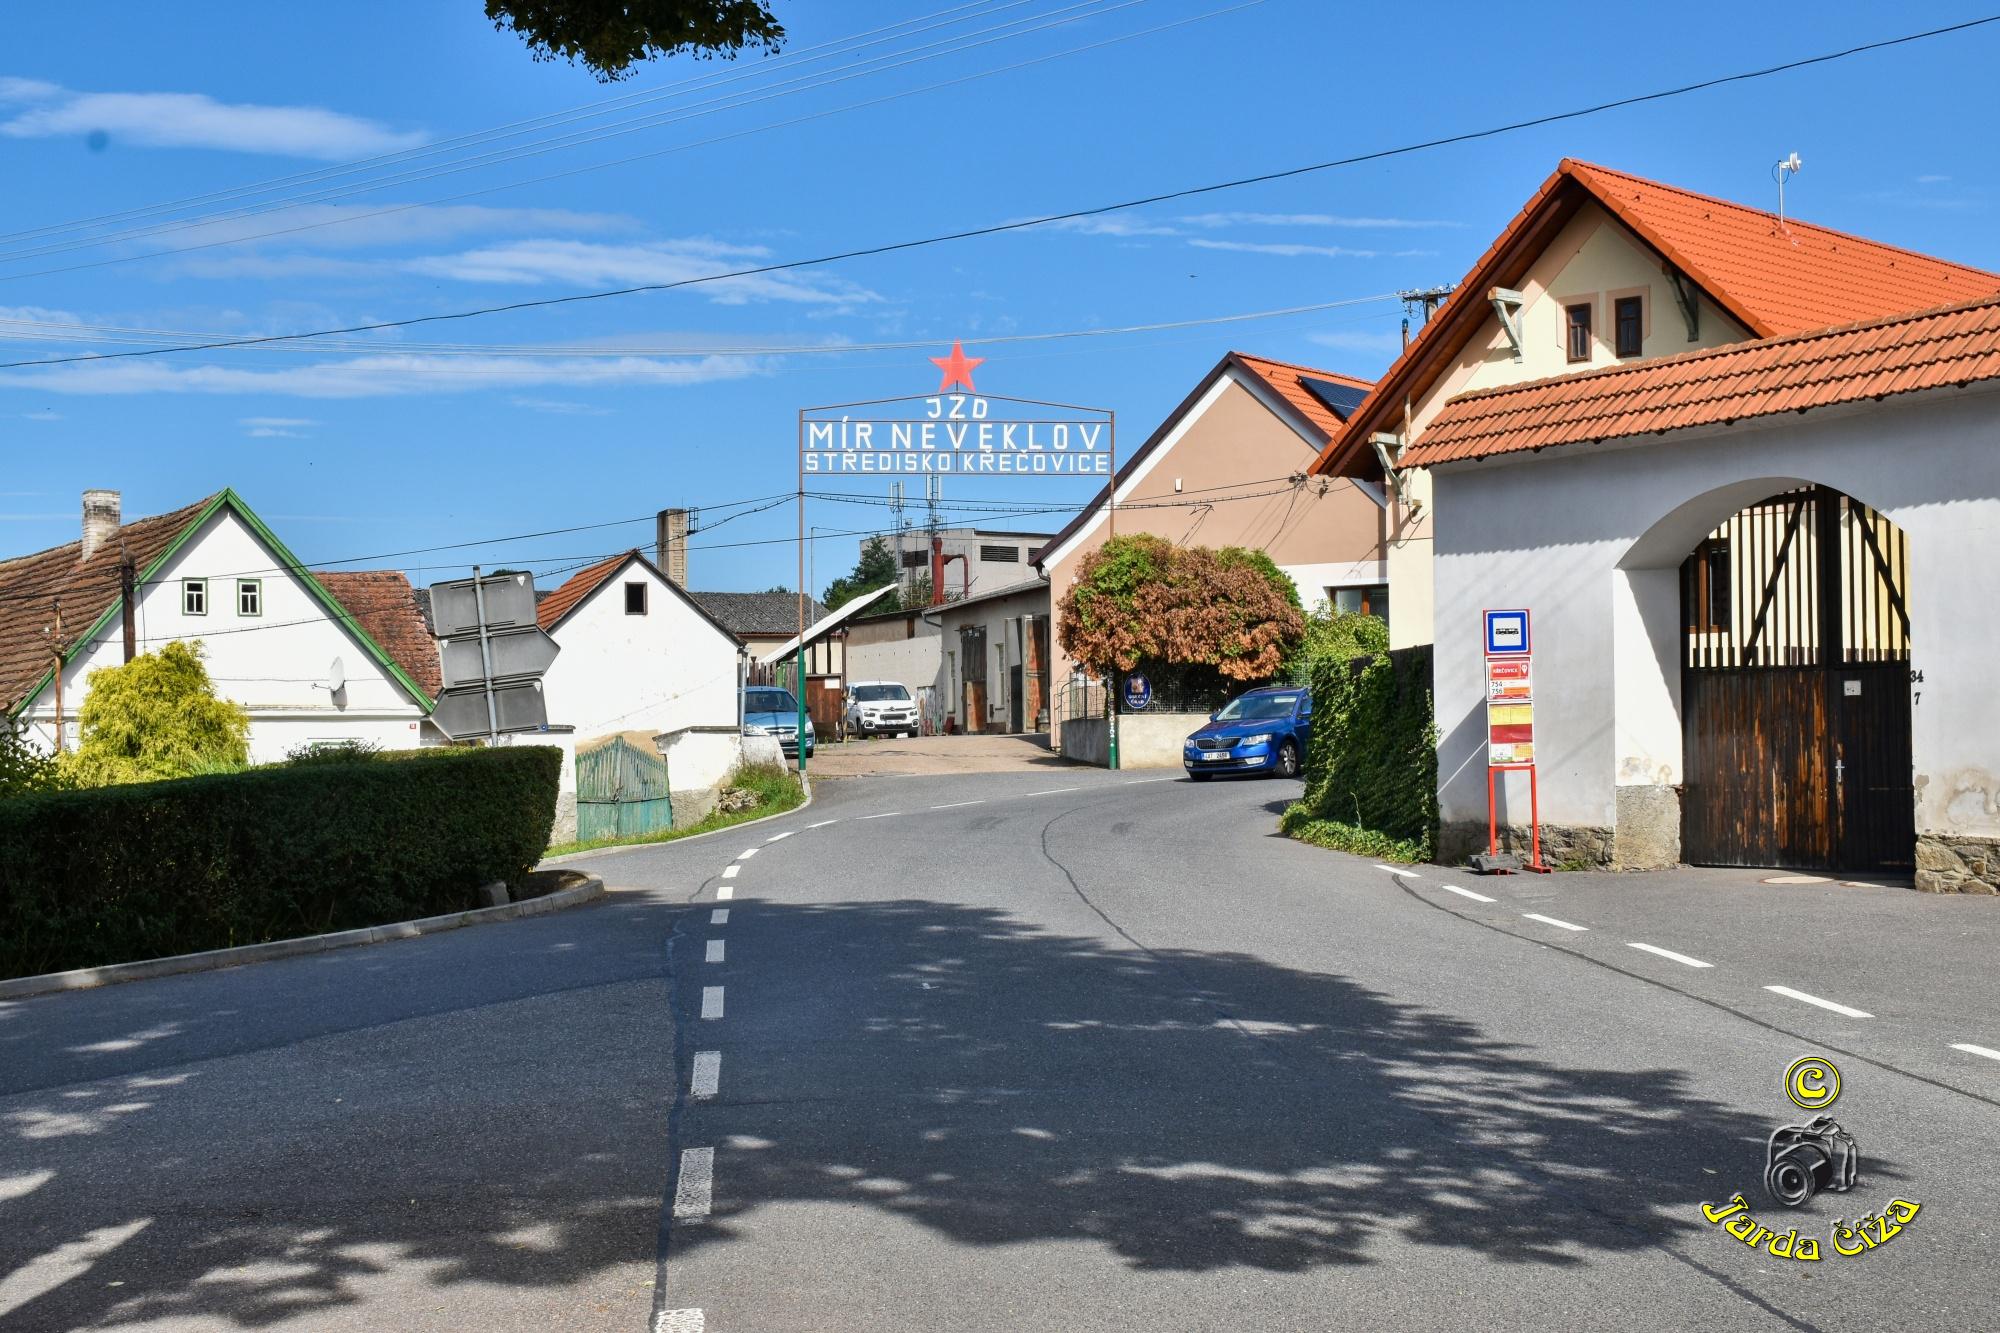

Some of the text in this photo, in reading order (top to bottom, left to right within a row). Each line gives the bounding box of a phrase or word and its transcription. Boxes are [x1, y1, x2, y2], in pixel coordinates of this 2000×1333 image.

[926, 395, 988, 419] JZD
[809, 415, 1101, 450] MÍR NEVEKLOV
[806, 448, 1108, 472] STŘEDISKO KŘEČOVICE
[1910, 669, 1924, 683] 34
[1914, 691, 1921, 705] 7
